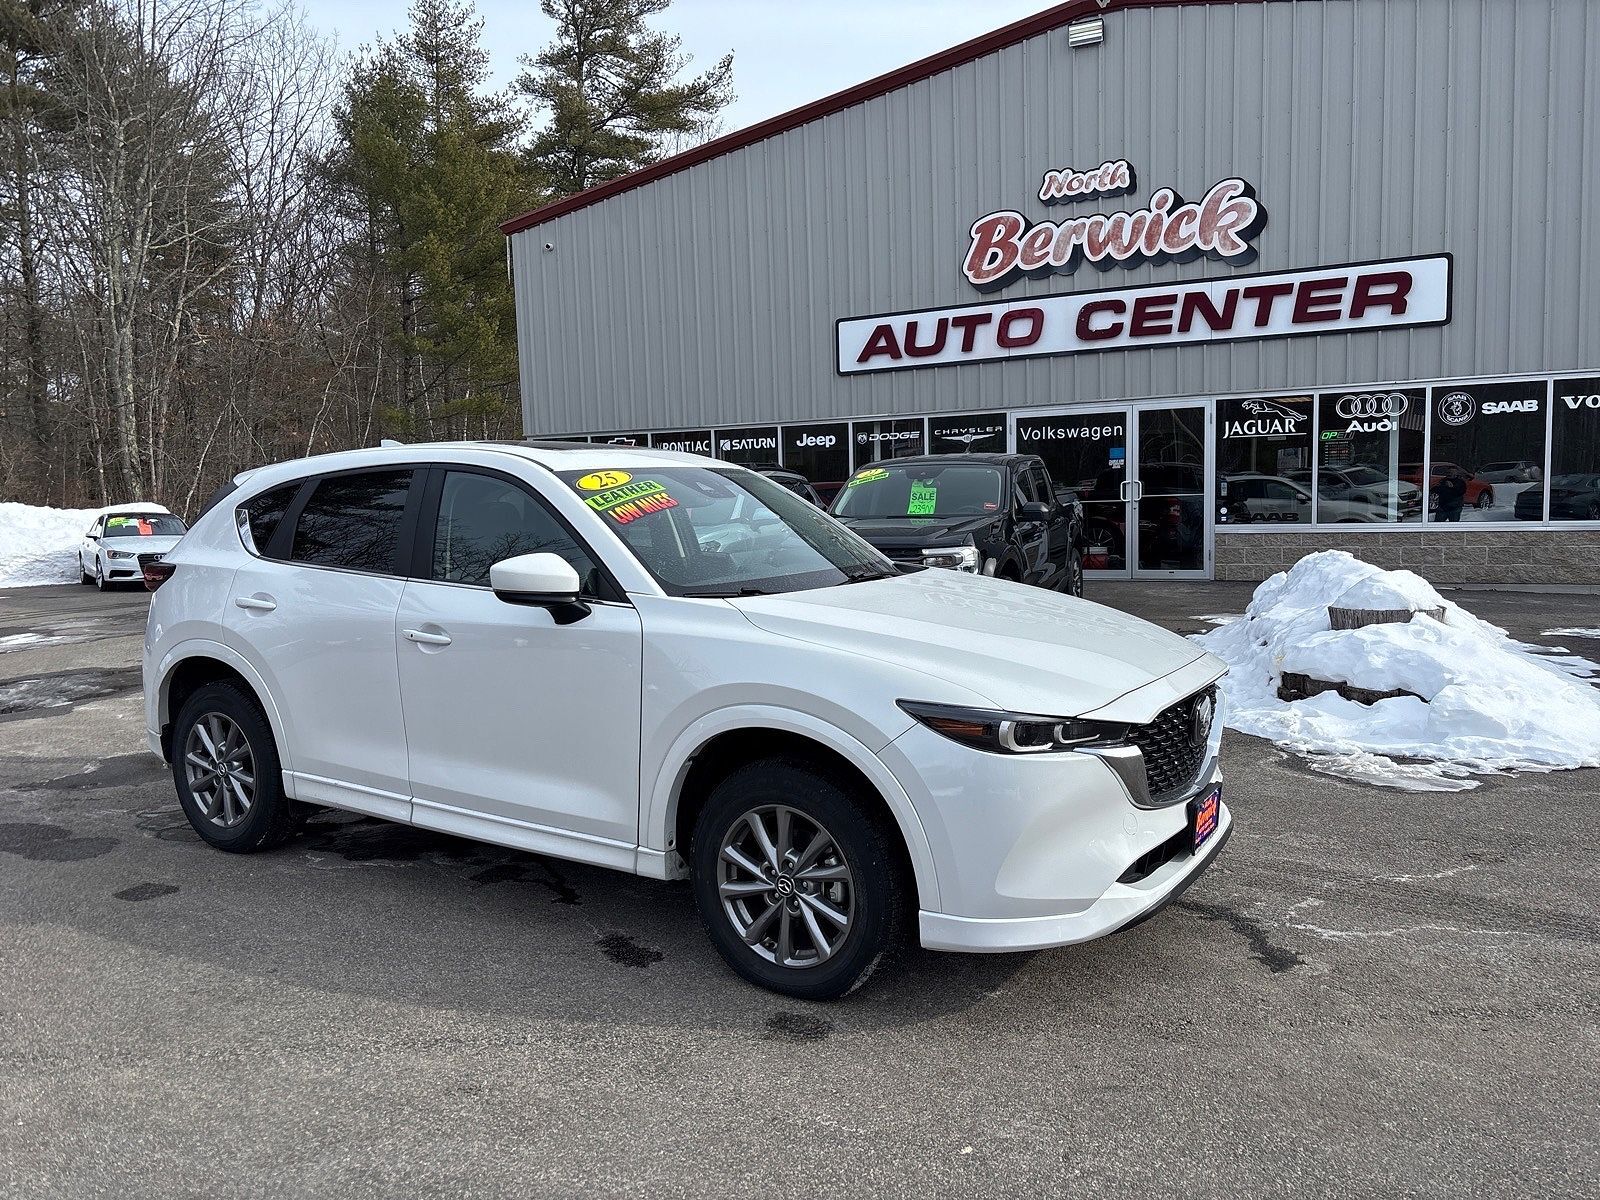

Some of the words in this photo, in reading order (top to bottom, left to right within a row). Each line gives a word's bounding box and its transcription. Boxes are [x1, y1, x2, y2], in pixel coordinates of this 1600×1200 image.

[1040, 162, 1130, 198] North
[964, 180, 1257, 282] Berwick
[856, 307, 1045, 363] AUTO
[1075, 271, 1413, 341] CENTER
[1448, 394, 1467, 402] SAAB
[1481, 399, 1539, 415] SAAB
[934, 426, 1003, 436] CHRYSLER
[1020, 425, 1123, 441] Volkswagen
[1223, 418, 1297, 439] JAGUAR
[1346, 418, 1398, 433] Audi
[796, 433, 836, 448] Jeep
[869, 431, 920, 441] DODGE
[662, 440, 710, 452] PONTIAC
[732, 438, 776, 450] SATURN
[590, 472, 619, 488] 25
[591, 481, 658, 507] LEATHER
[911, 492, 935, 501] SALE
[607, 502, 645, 524] LOW
[635, 492, 678, 514] MILES
[1233, 512, 1300, 522] SAAB
